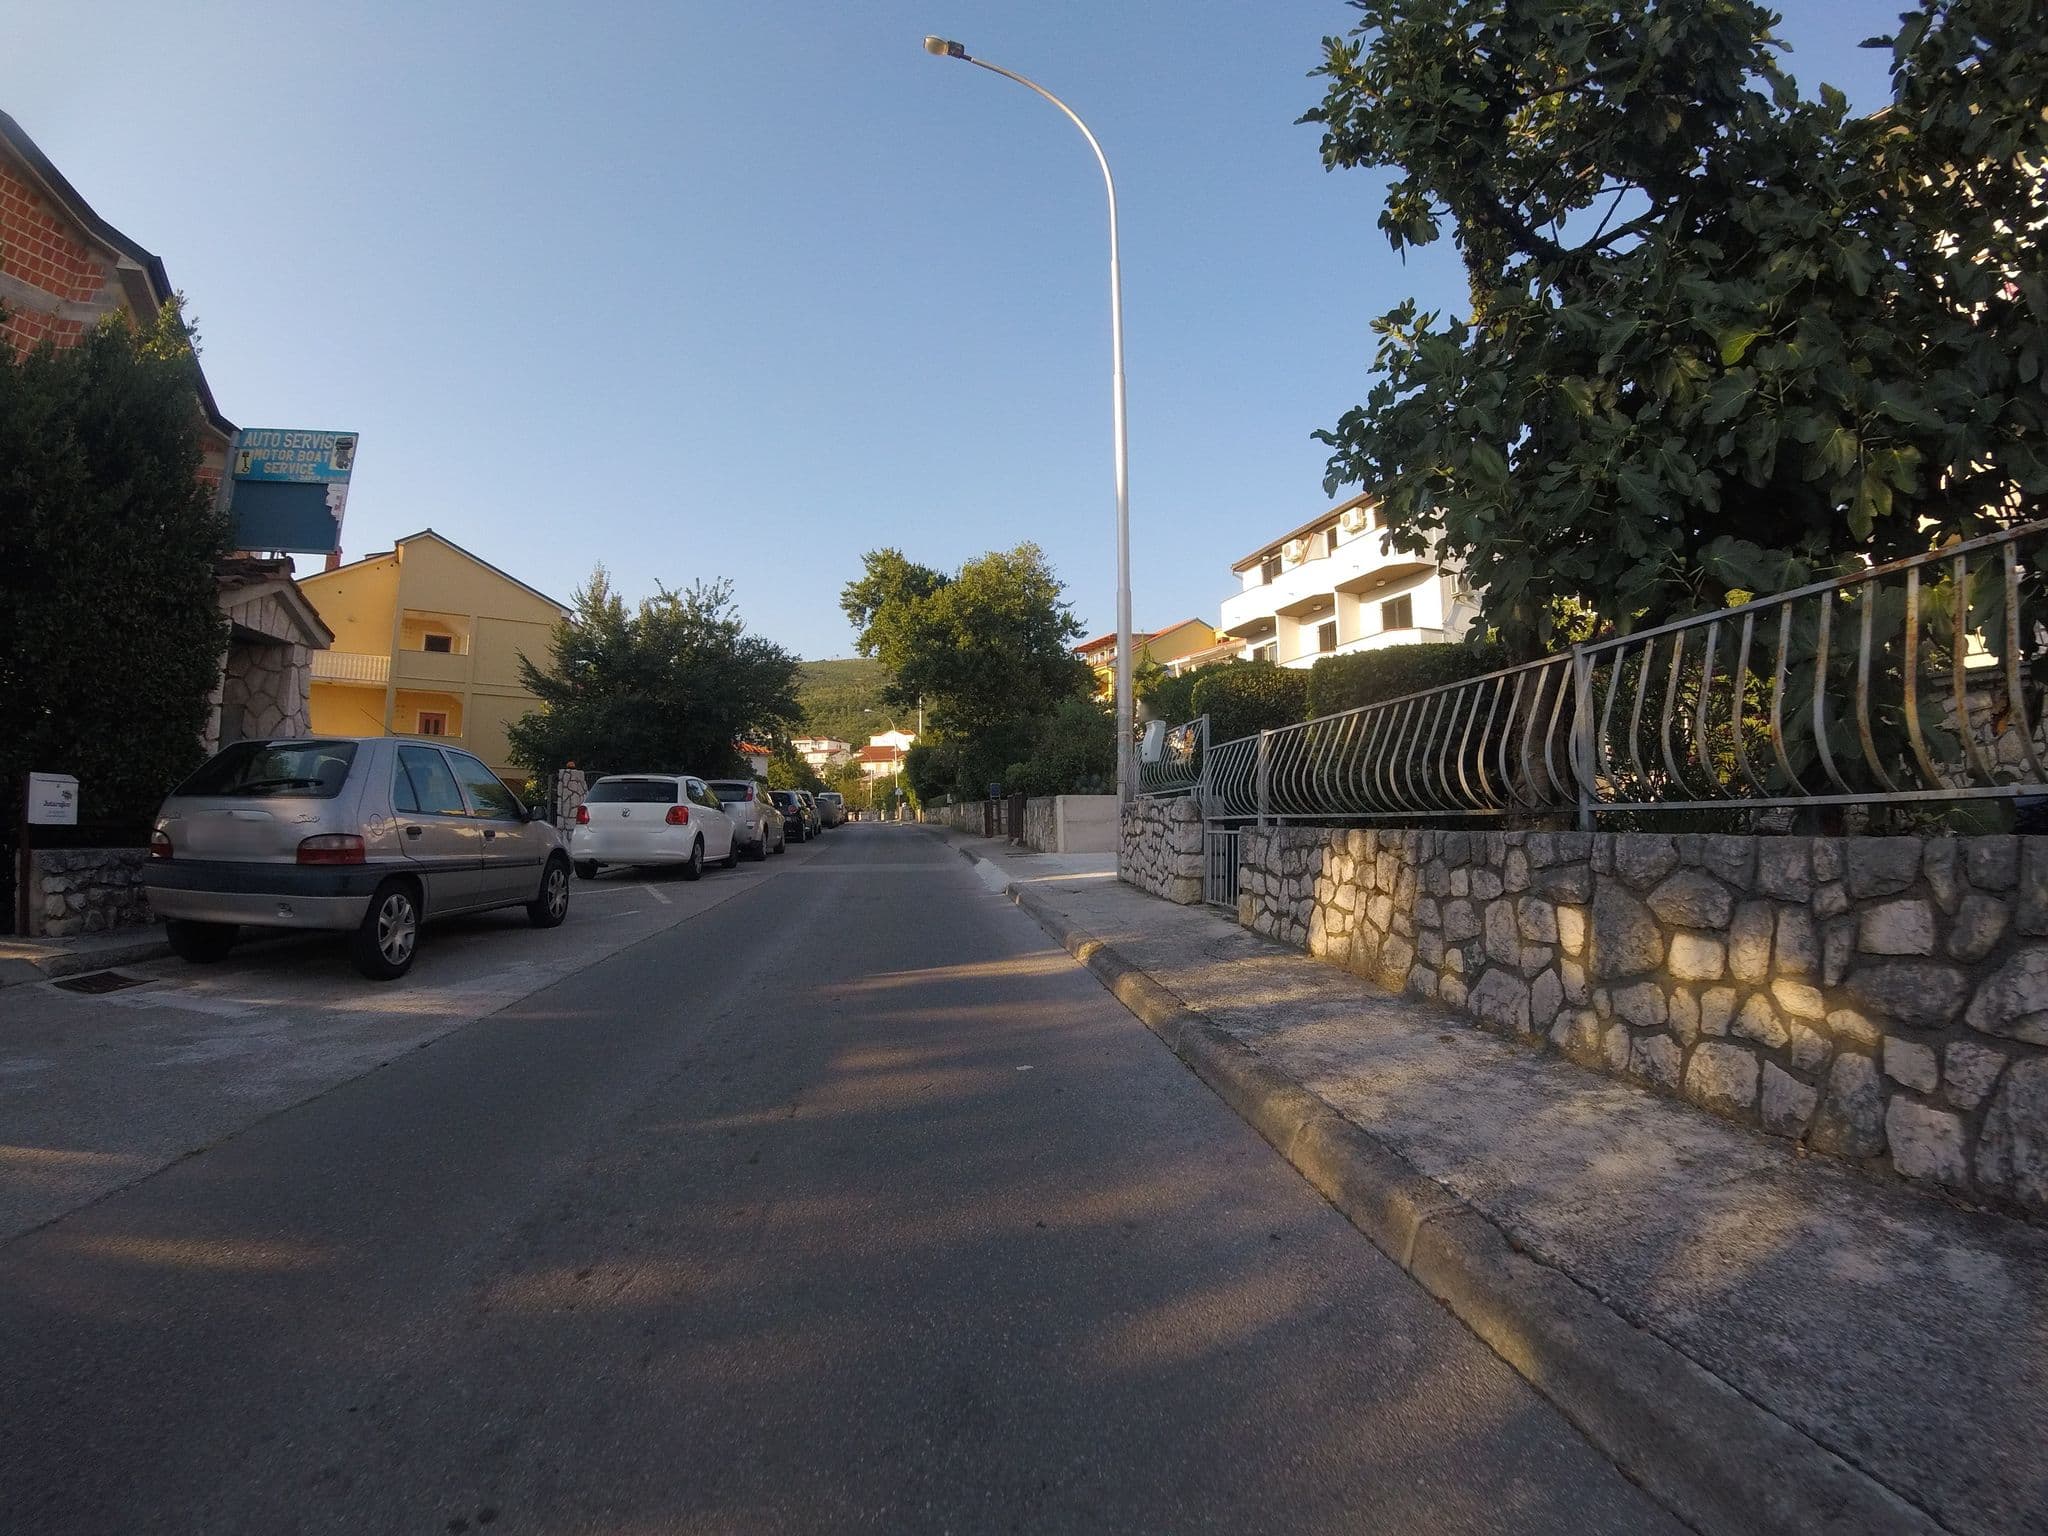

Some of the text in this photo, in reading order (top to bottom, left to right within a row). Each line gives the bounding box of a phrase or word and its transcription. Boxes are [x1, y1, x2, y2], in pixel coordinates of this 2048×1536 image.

[244, 432, 334, 449] AUTO SERVIS
[252, 448, 330, 462] MOTOR BOAT
[263, 462, 316, 475] SERVICE
